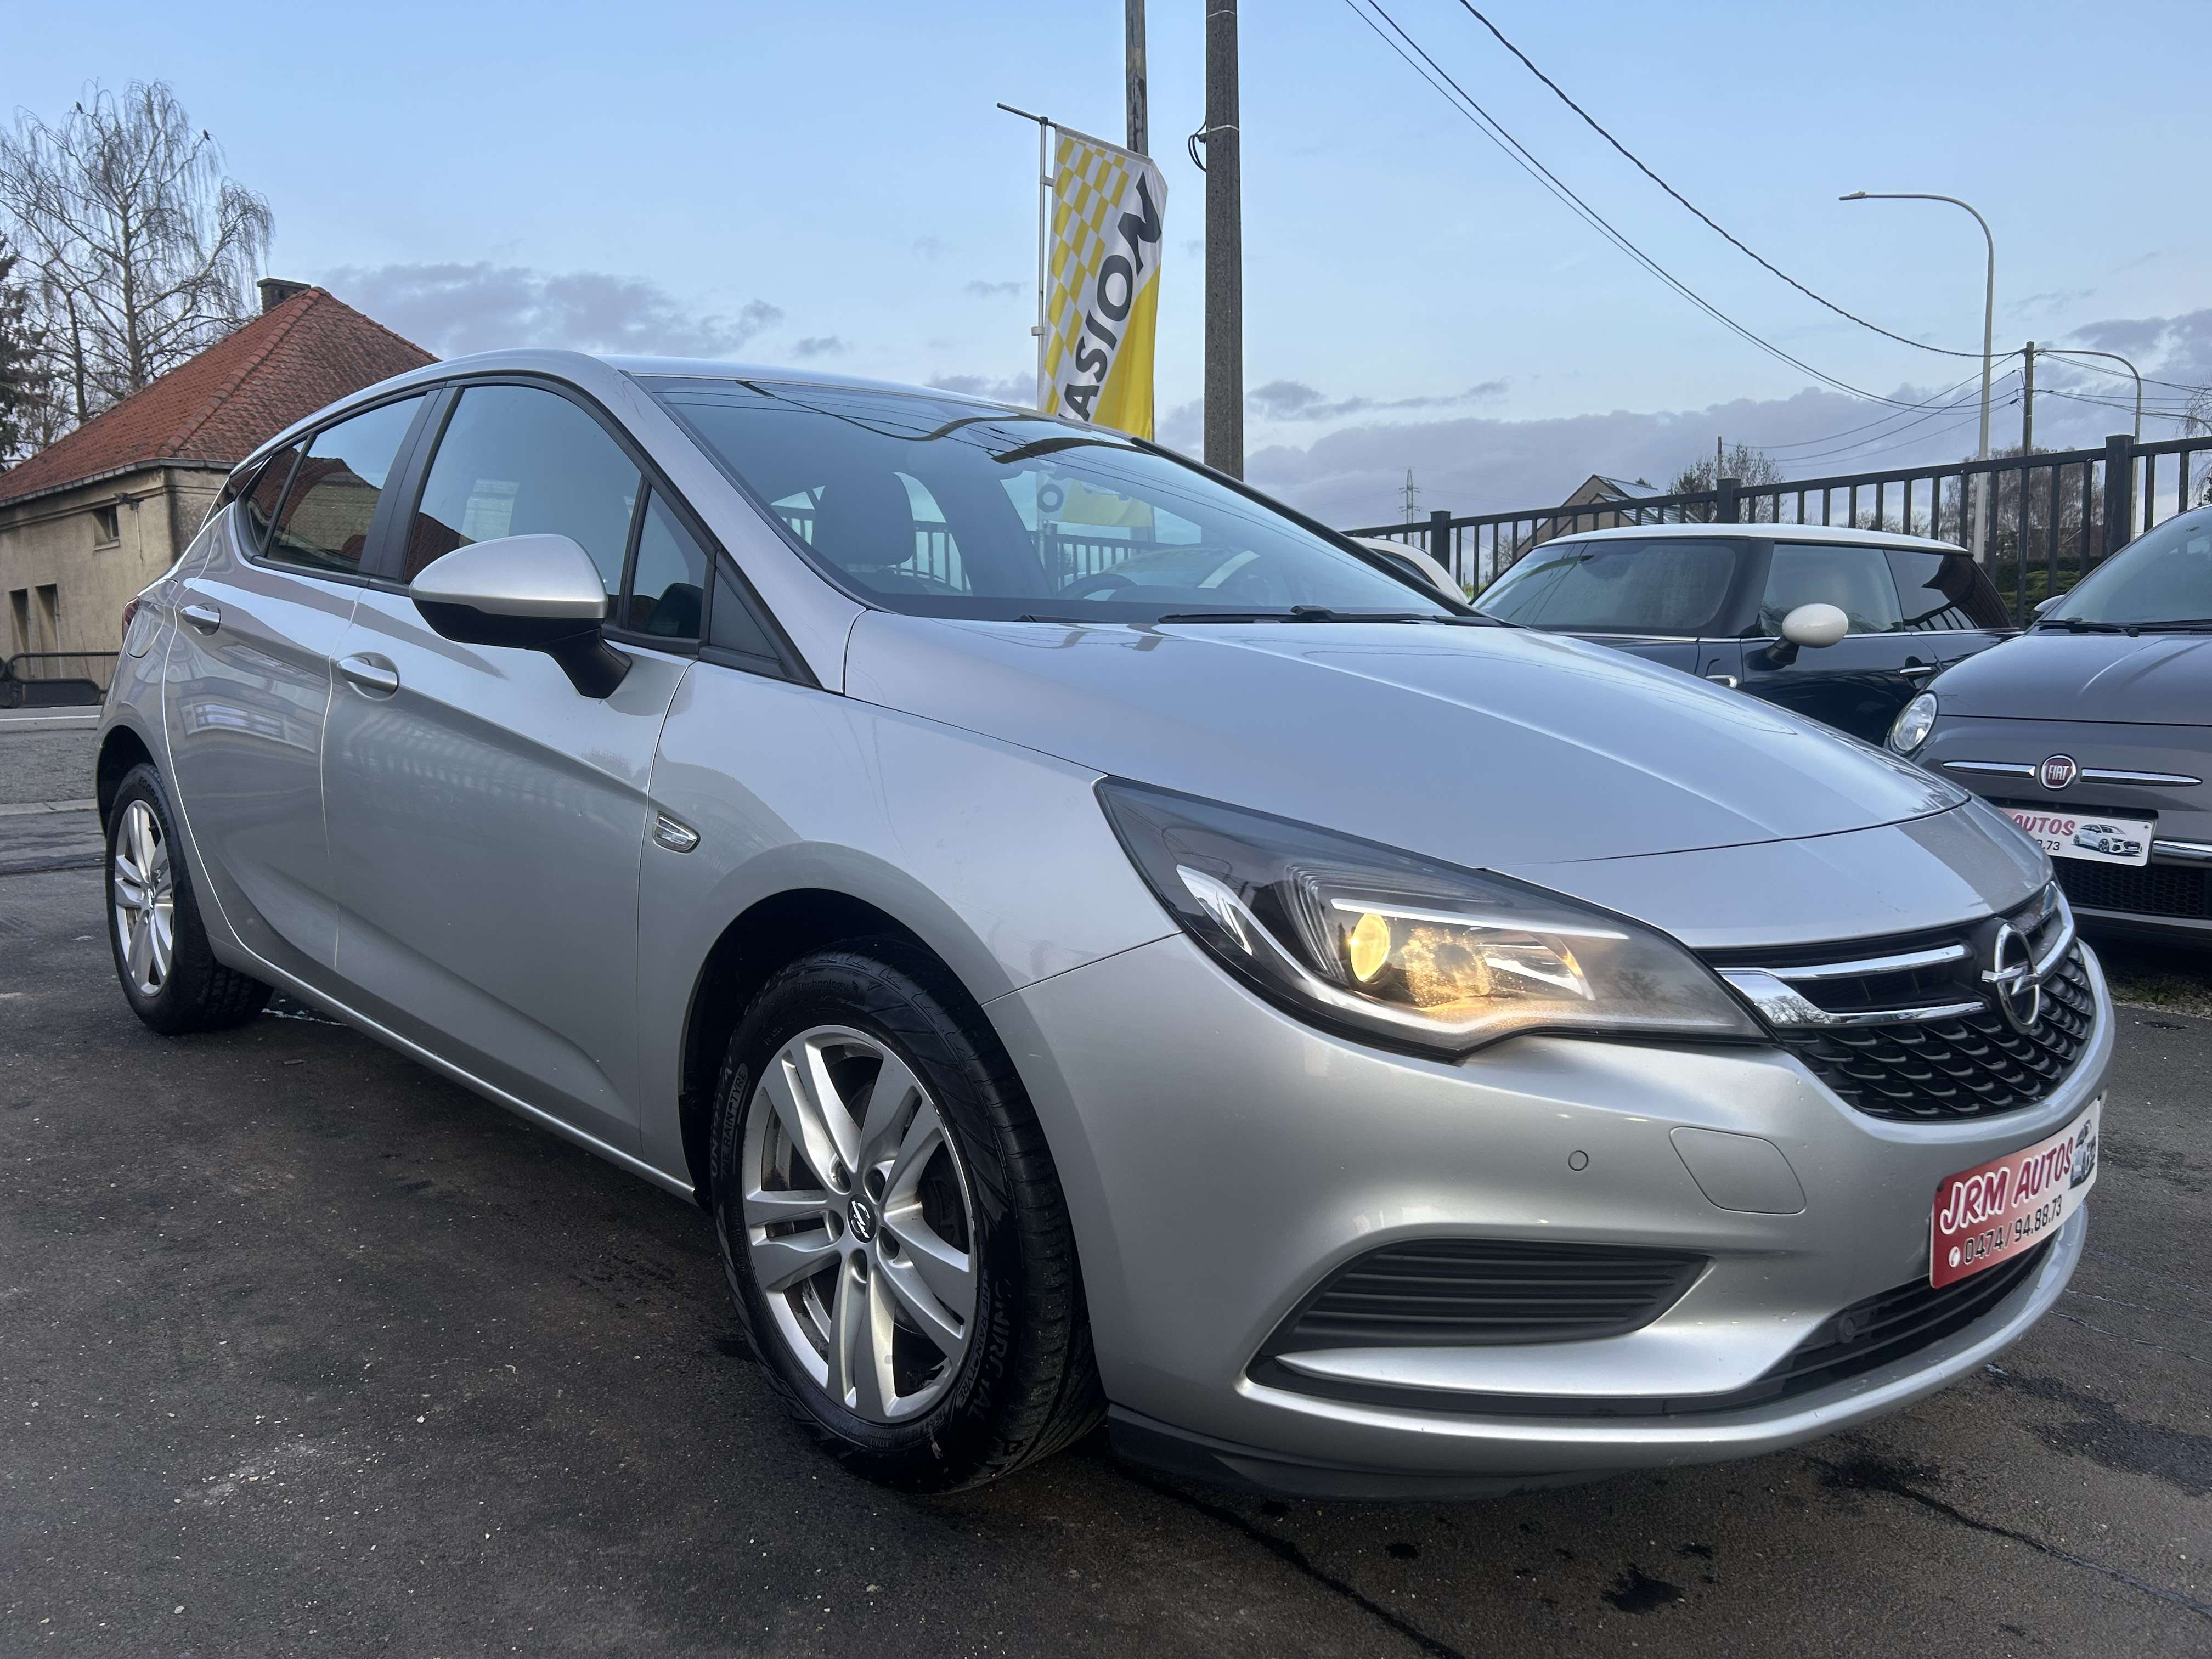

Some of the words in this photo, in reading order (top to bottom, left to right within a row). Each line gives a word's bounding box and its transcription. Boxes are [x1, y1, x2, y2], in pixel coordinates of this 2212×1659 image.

[1058, 171, 1161, 421] ASION
[2047, 765, 2070, 780] FIAT
[723, 1111, 734, 1147] RAIN
[730, 1069, 747, 1102] TYRE
[1940, 1167, 2010, 1234] JRM
[2012, 1136, 2073, 1209] AUTOS
[972, 1317, 987, 1356] RAIN
[958, 1365, 979, 1403] TYRE
